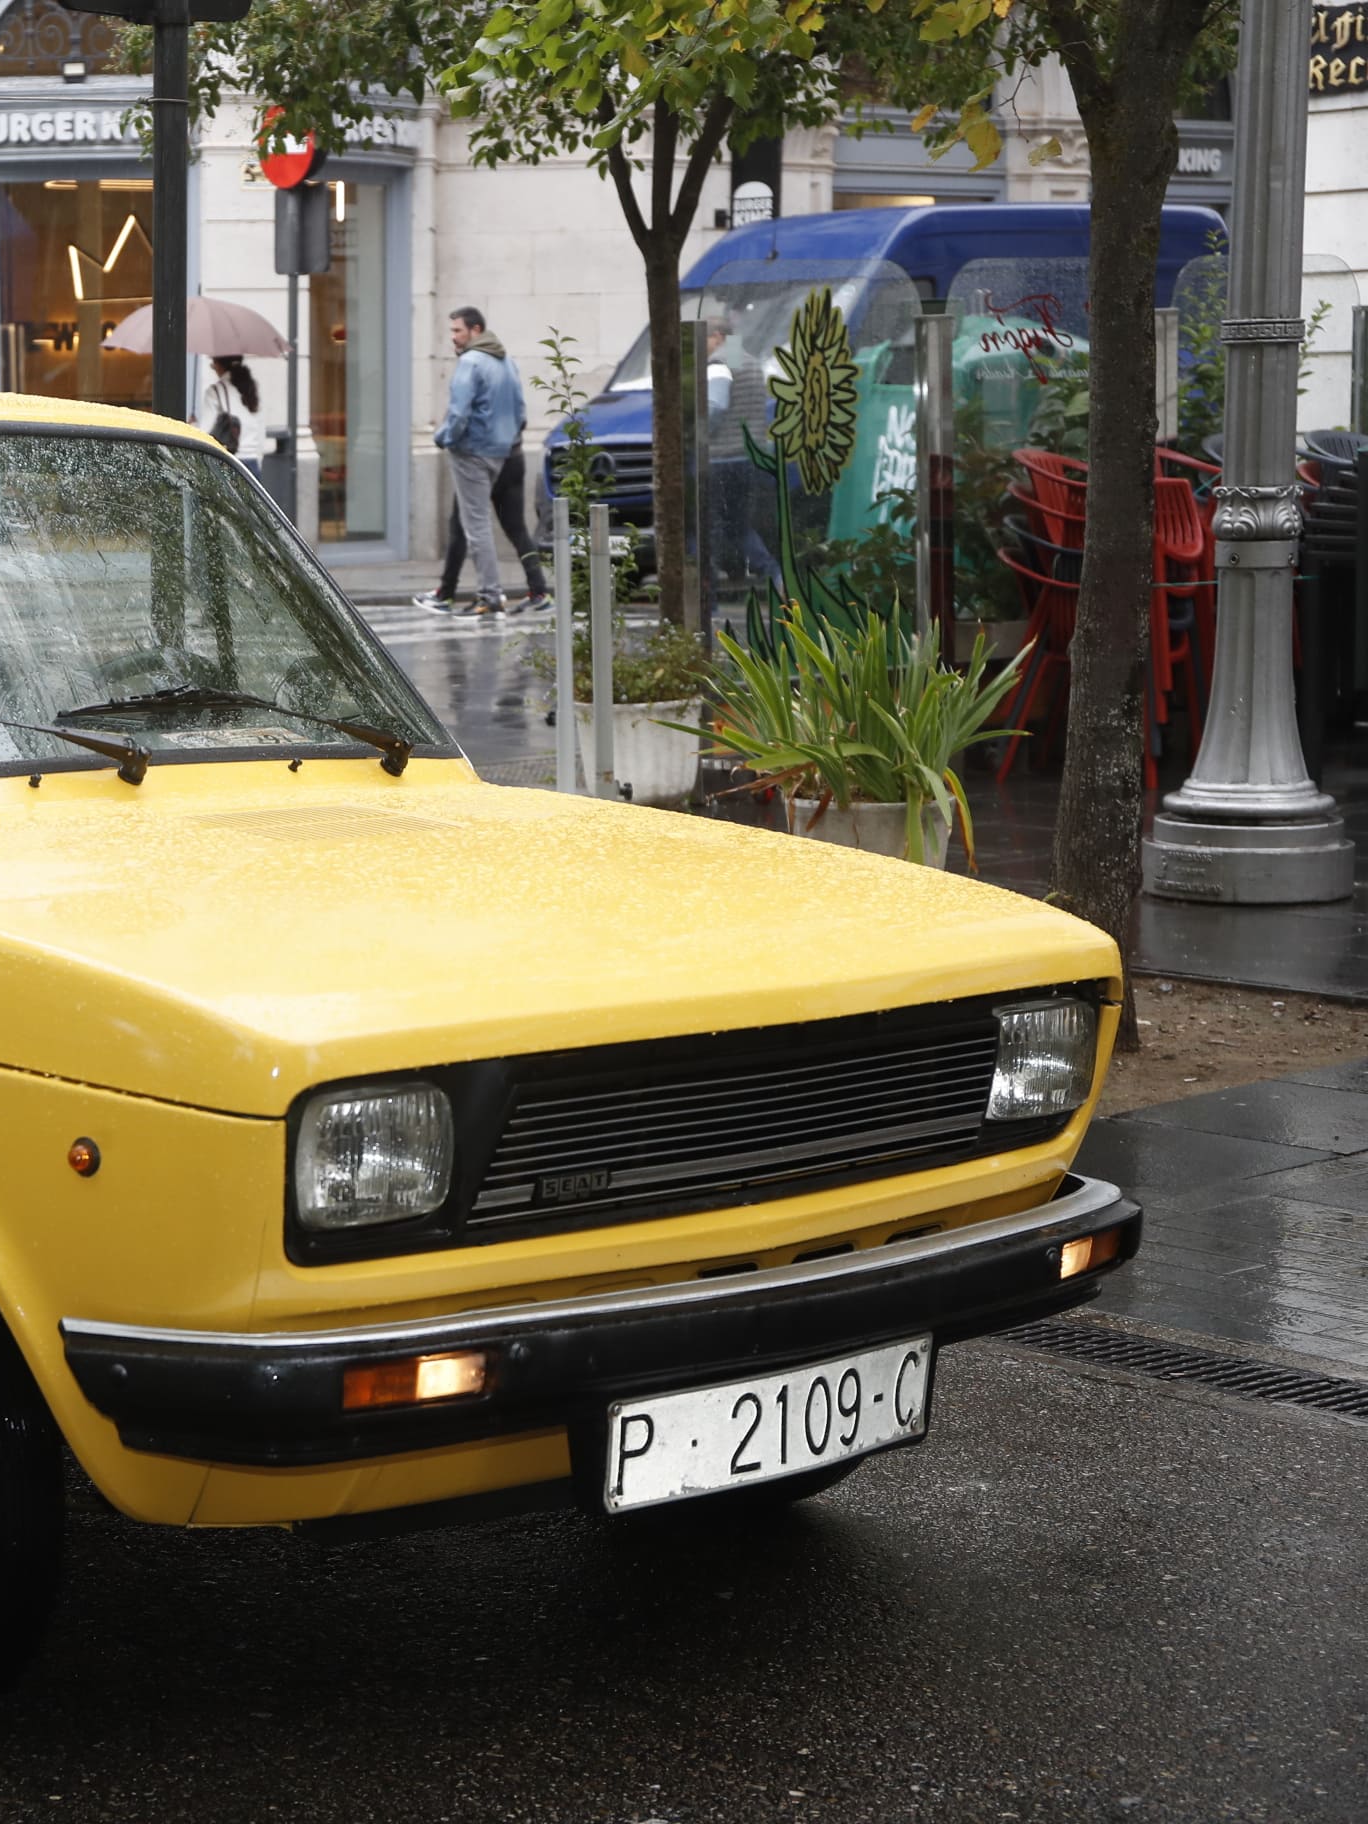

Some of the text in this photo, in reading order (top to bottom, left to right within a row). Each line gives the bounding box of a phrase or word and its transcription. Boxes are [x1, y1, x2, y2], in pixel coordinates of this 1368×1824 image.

[1309, 54, 1368, 90] Rec
[1178, 148, 1222, 172] KING
[542, 1170, 609, 1198] SEAT
